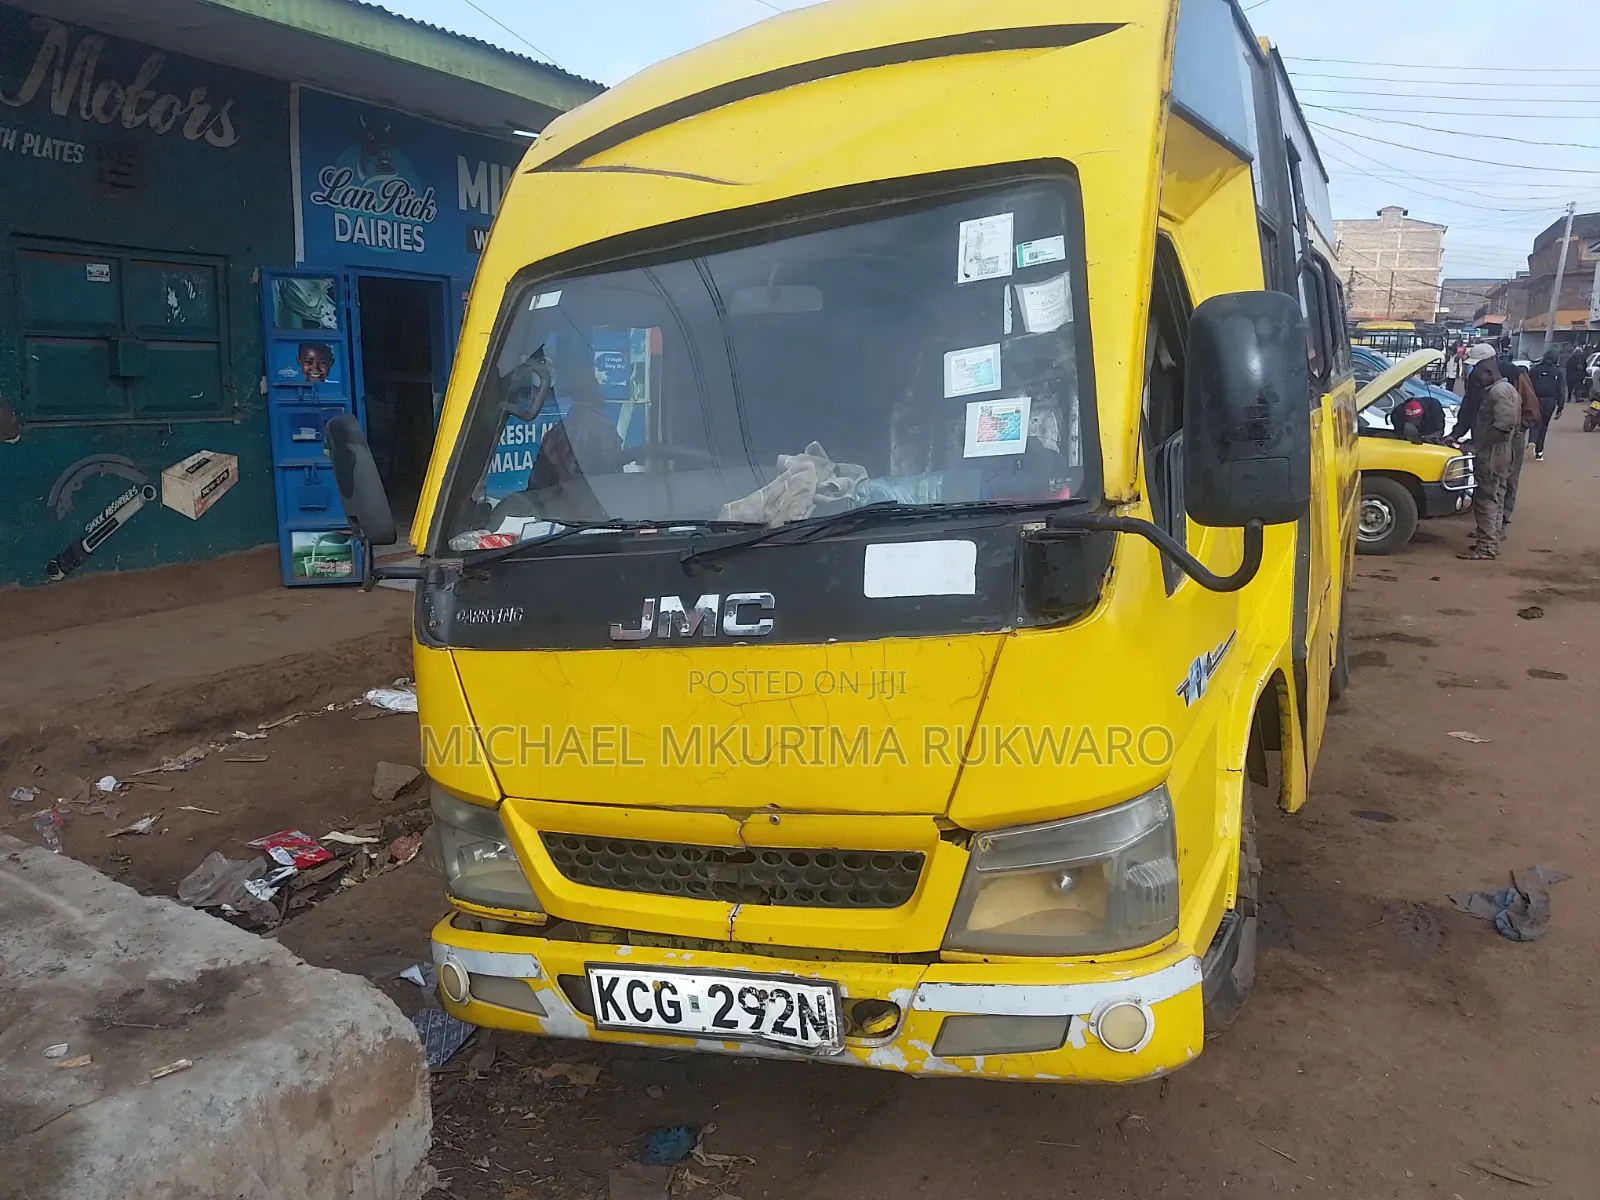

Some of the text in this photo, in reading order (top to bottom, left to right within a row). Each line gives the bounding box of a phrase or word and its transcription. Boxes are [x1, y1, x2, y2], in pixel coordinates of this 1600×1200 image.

[0, 17, 241, 148] Motors
[21, 132, 86, 164] PLATES
[334, 212, 426, 253] DAIRIES
[497, 423, 536, 446] RESH
[488, 450, 534, 474] MALA
[85, 512, 106, 533] SHOCK
[105, 485, 139, 518] ABSORBERS
[609, 591, 776, 641] JMC
[595, 974, 831, 1041] KCG 292N
